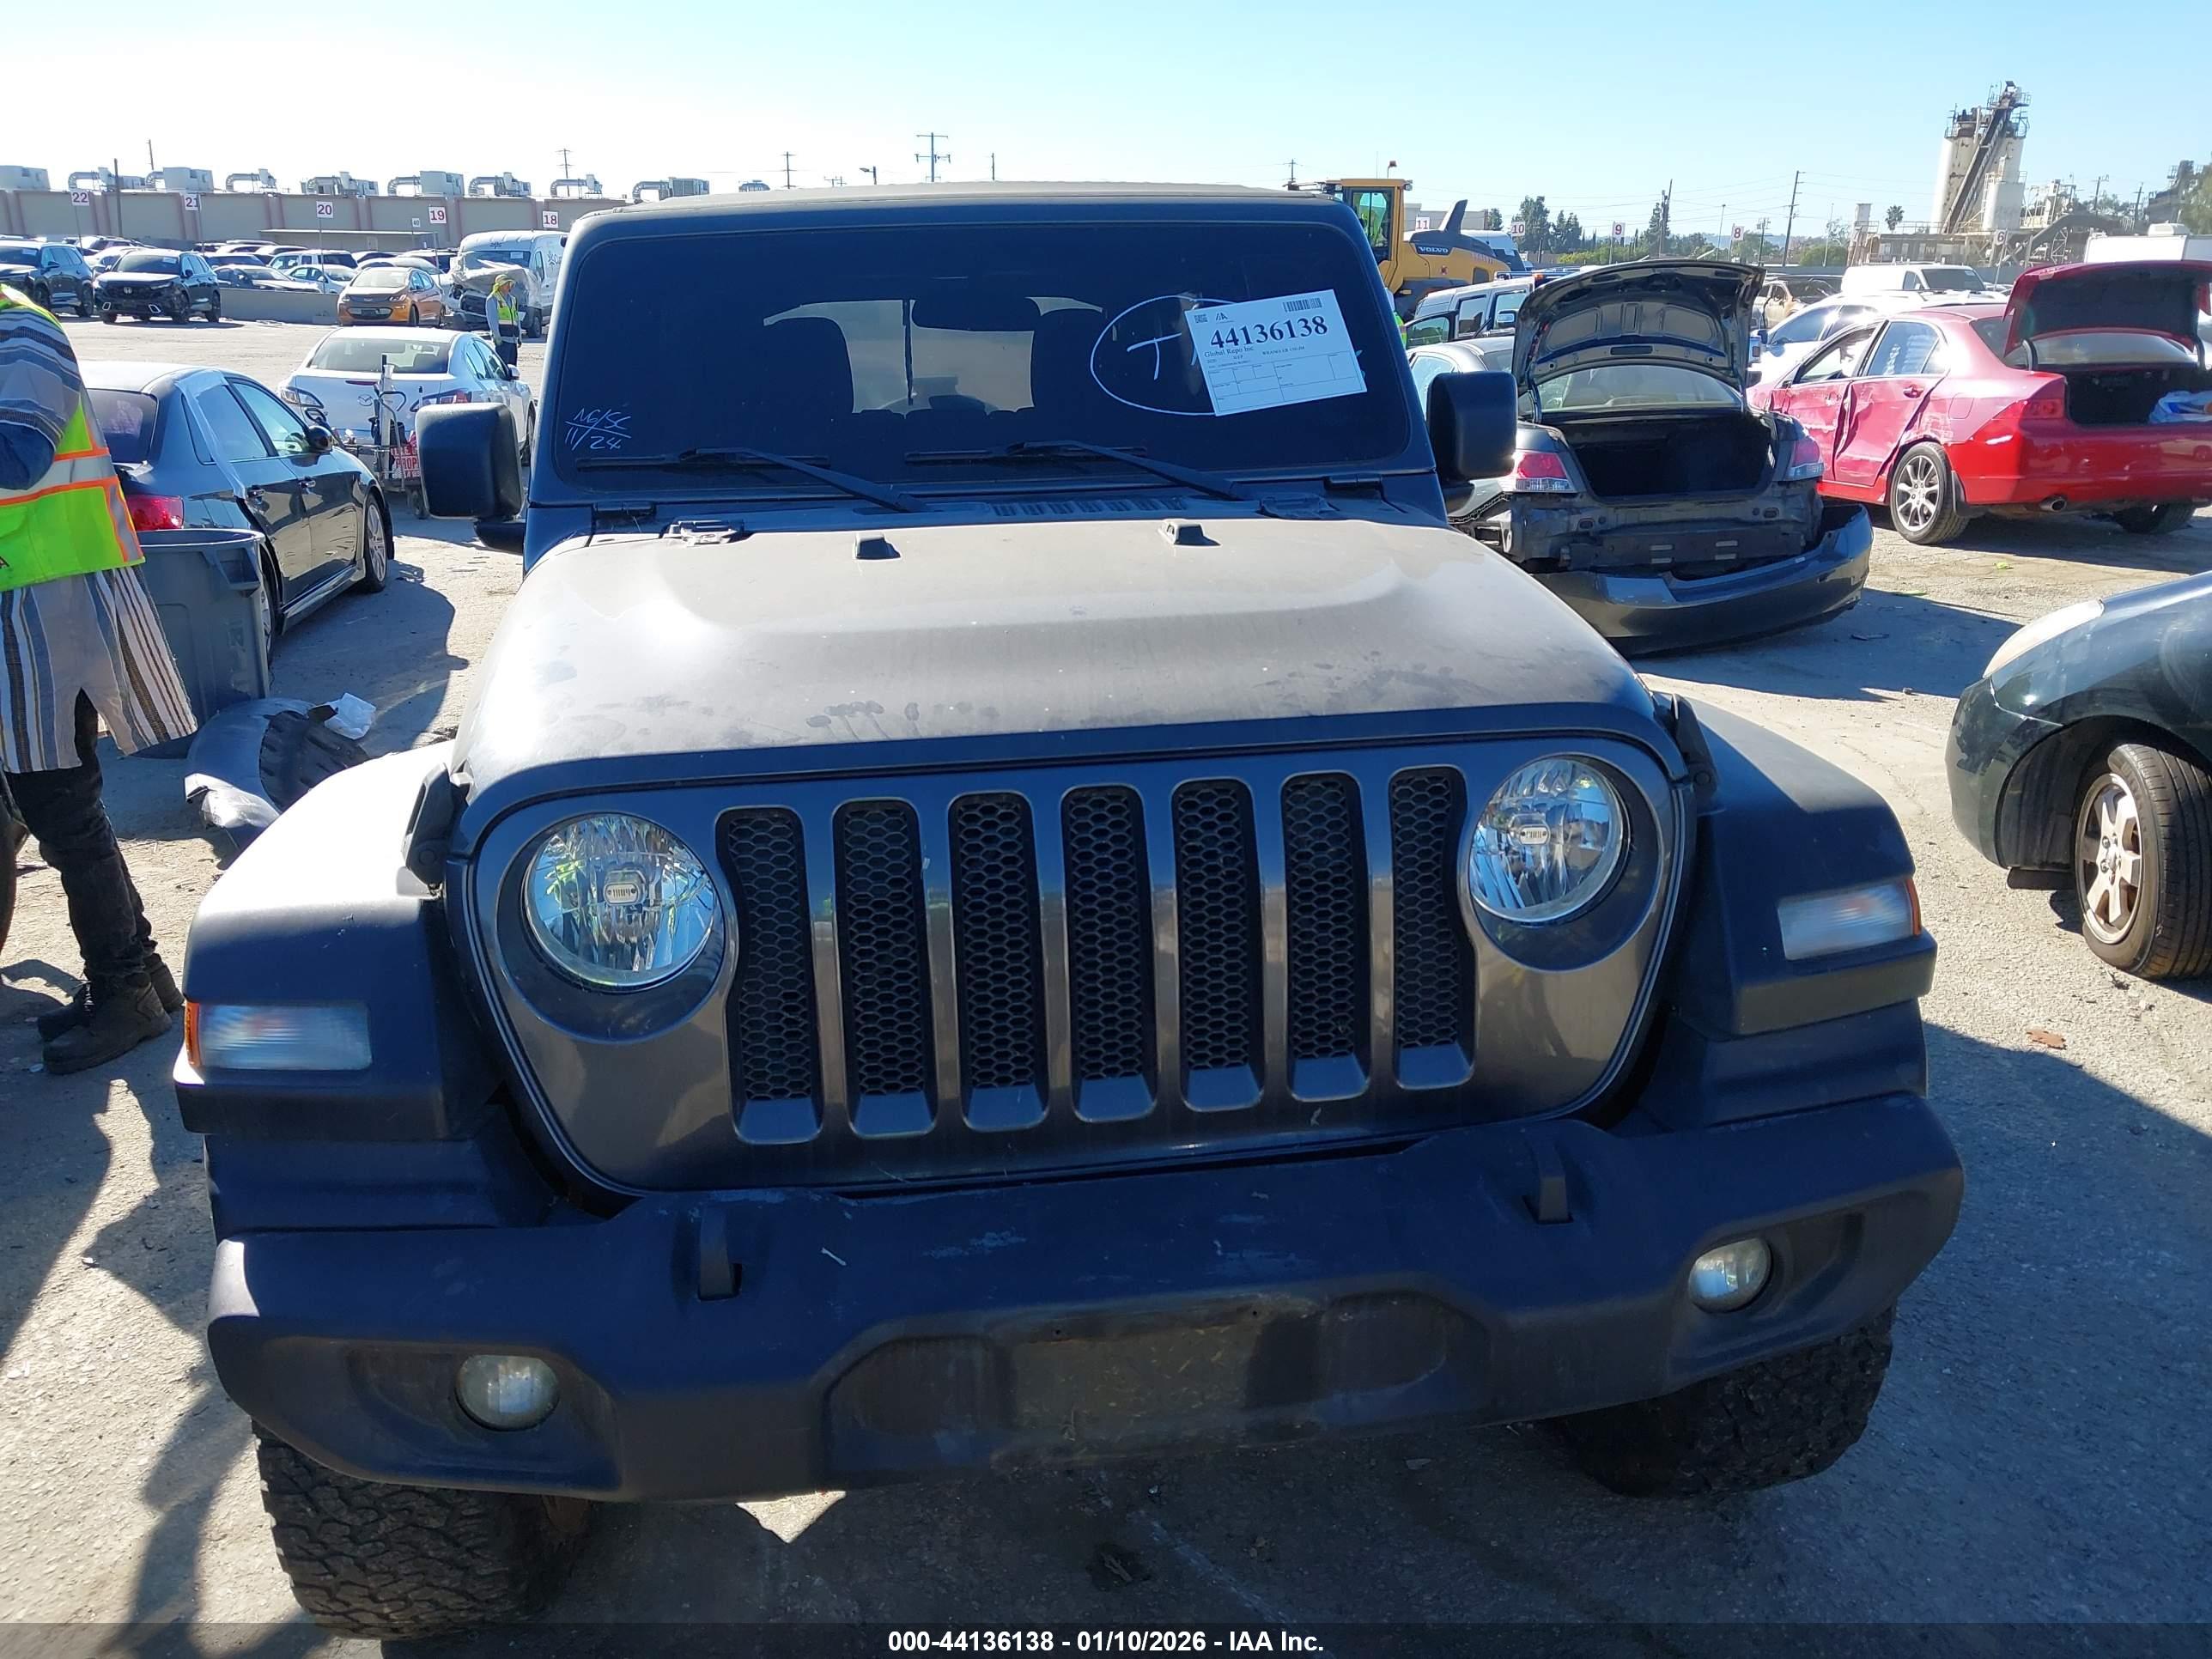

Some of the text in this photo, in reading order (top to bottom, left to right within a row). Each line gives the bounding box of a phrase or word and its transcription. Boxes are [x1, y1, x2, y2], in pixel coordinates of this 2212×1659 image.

[72, 191, 88, 203] 22
[185, 197, 198, 208] 21
[317, 204, 332, 216] 20
[430, 210, 445, 221] 19
[544, 215, 557, 225] 18
[1417, 220, 1429, 229] 11
[1511, 223, 1524, 234] 10
[1615, 224, 1622, 235] 9
[1734, 227, 1741, 239] 8
[1997, 231, 2004, 241] 6
[1210, 315, 1328, 349] 44136138
